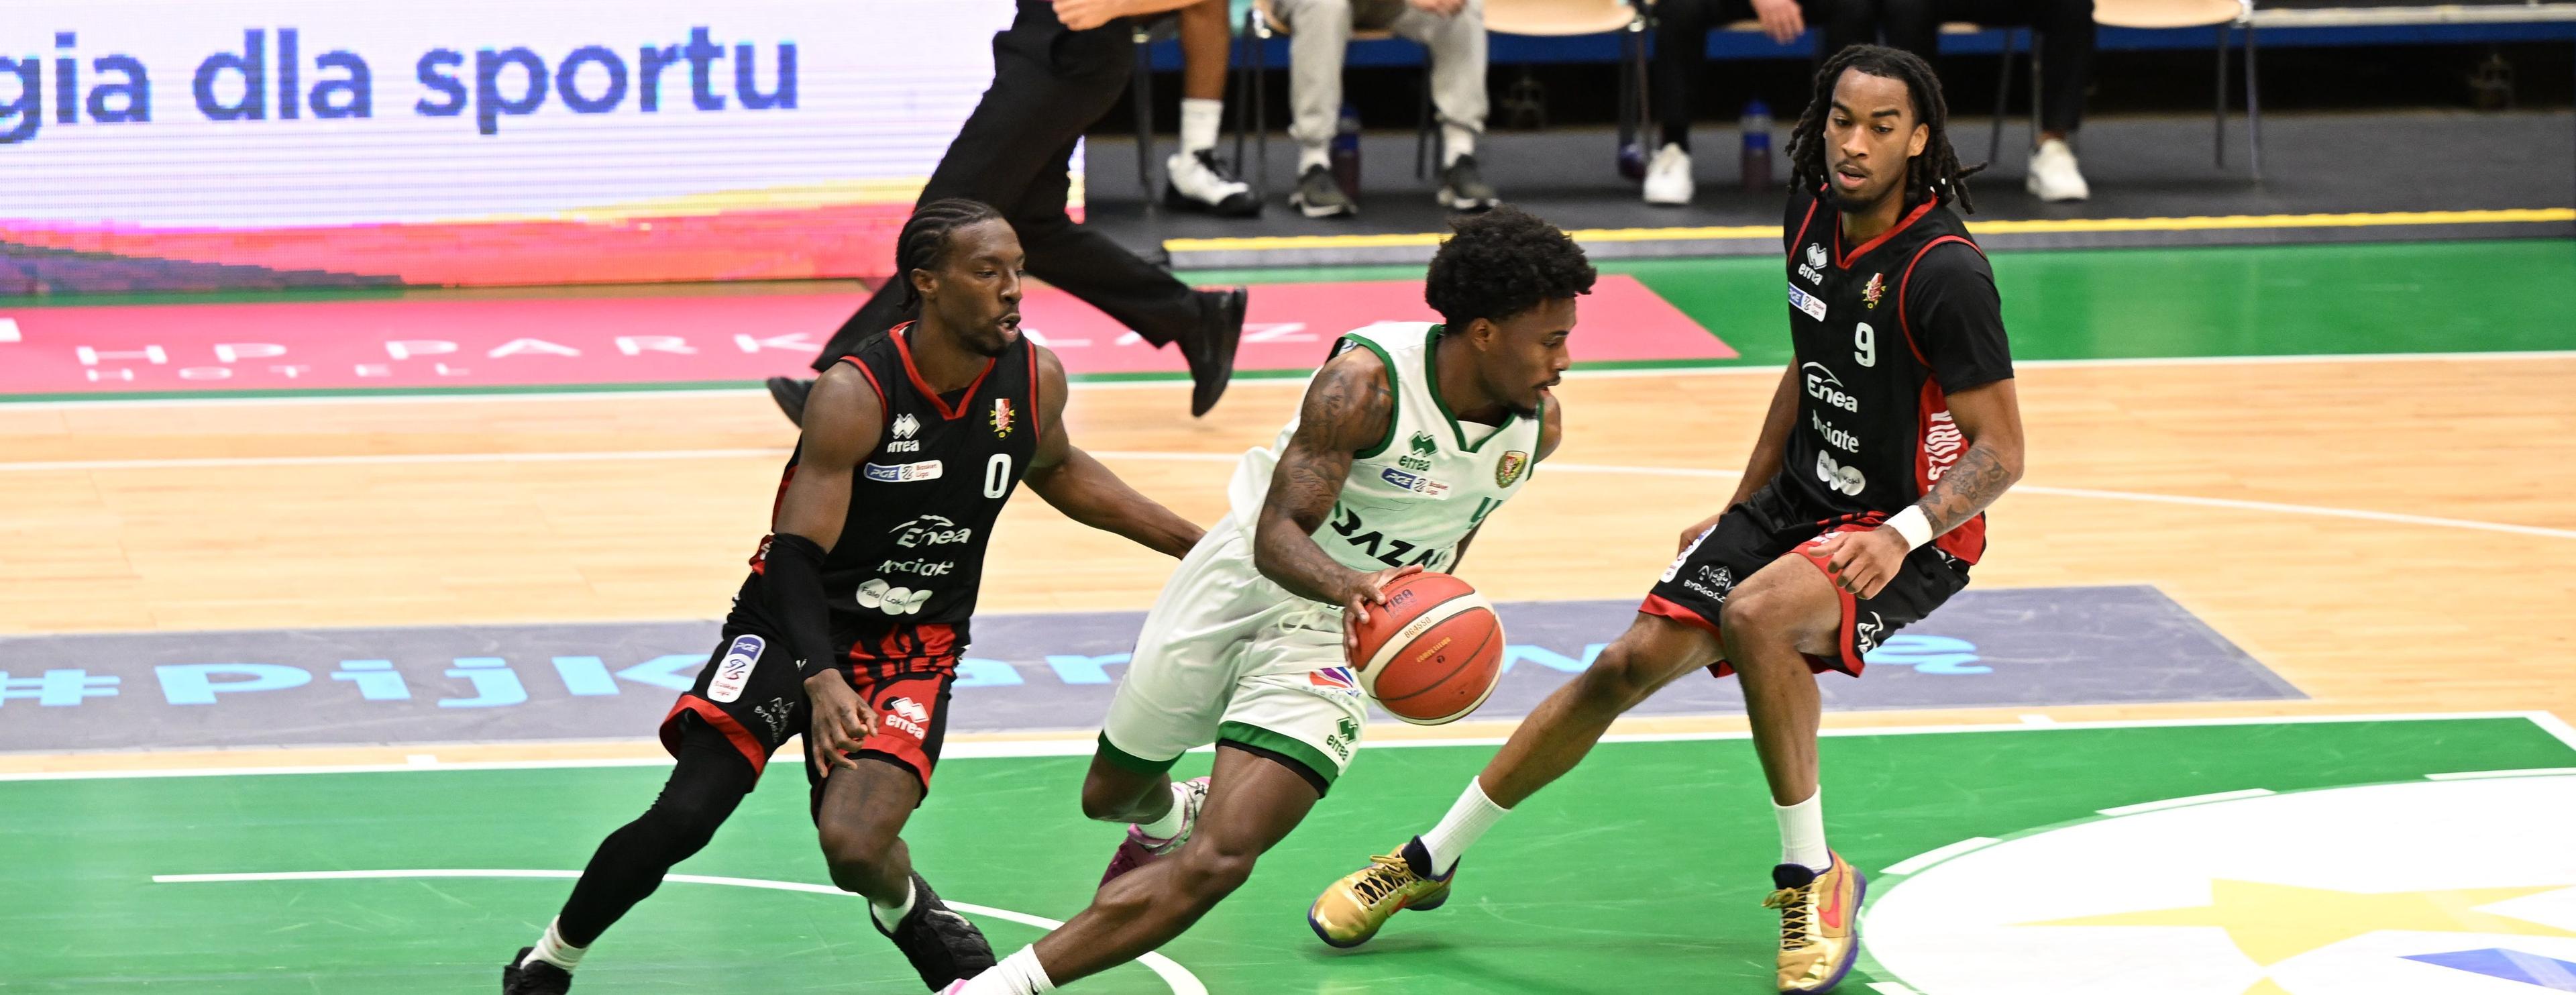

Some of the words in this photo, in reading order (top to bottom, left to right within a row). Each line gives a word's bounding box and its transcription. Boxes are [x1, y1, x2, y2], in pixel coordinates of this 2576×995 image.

[193, 27, 373, 121] dla
[415, 26, 798, 135] sportu
[386, 333, 824, 360] PARK
[1854, 322, 1876, 367] 9
[1807, 373, 1858, 413] Enea
[1399, 455, 1432, 472] errea
[1924, 410, 1963, 492] STORIA
[870, 469, 898, 478] PGE
[983, 454, 1012, 499] 0
[1386, 472, 1413, 486] PGE
[896, 527, 972, 548] Enea
[1383, 588, 1413, 613] FIBA
[735, 642, 759, 652] PGE
[885, 714, 925, 739] errea
[1326, 734, 1349, 761] errea
